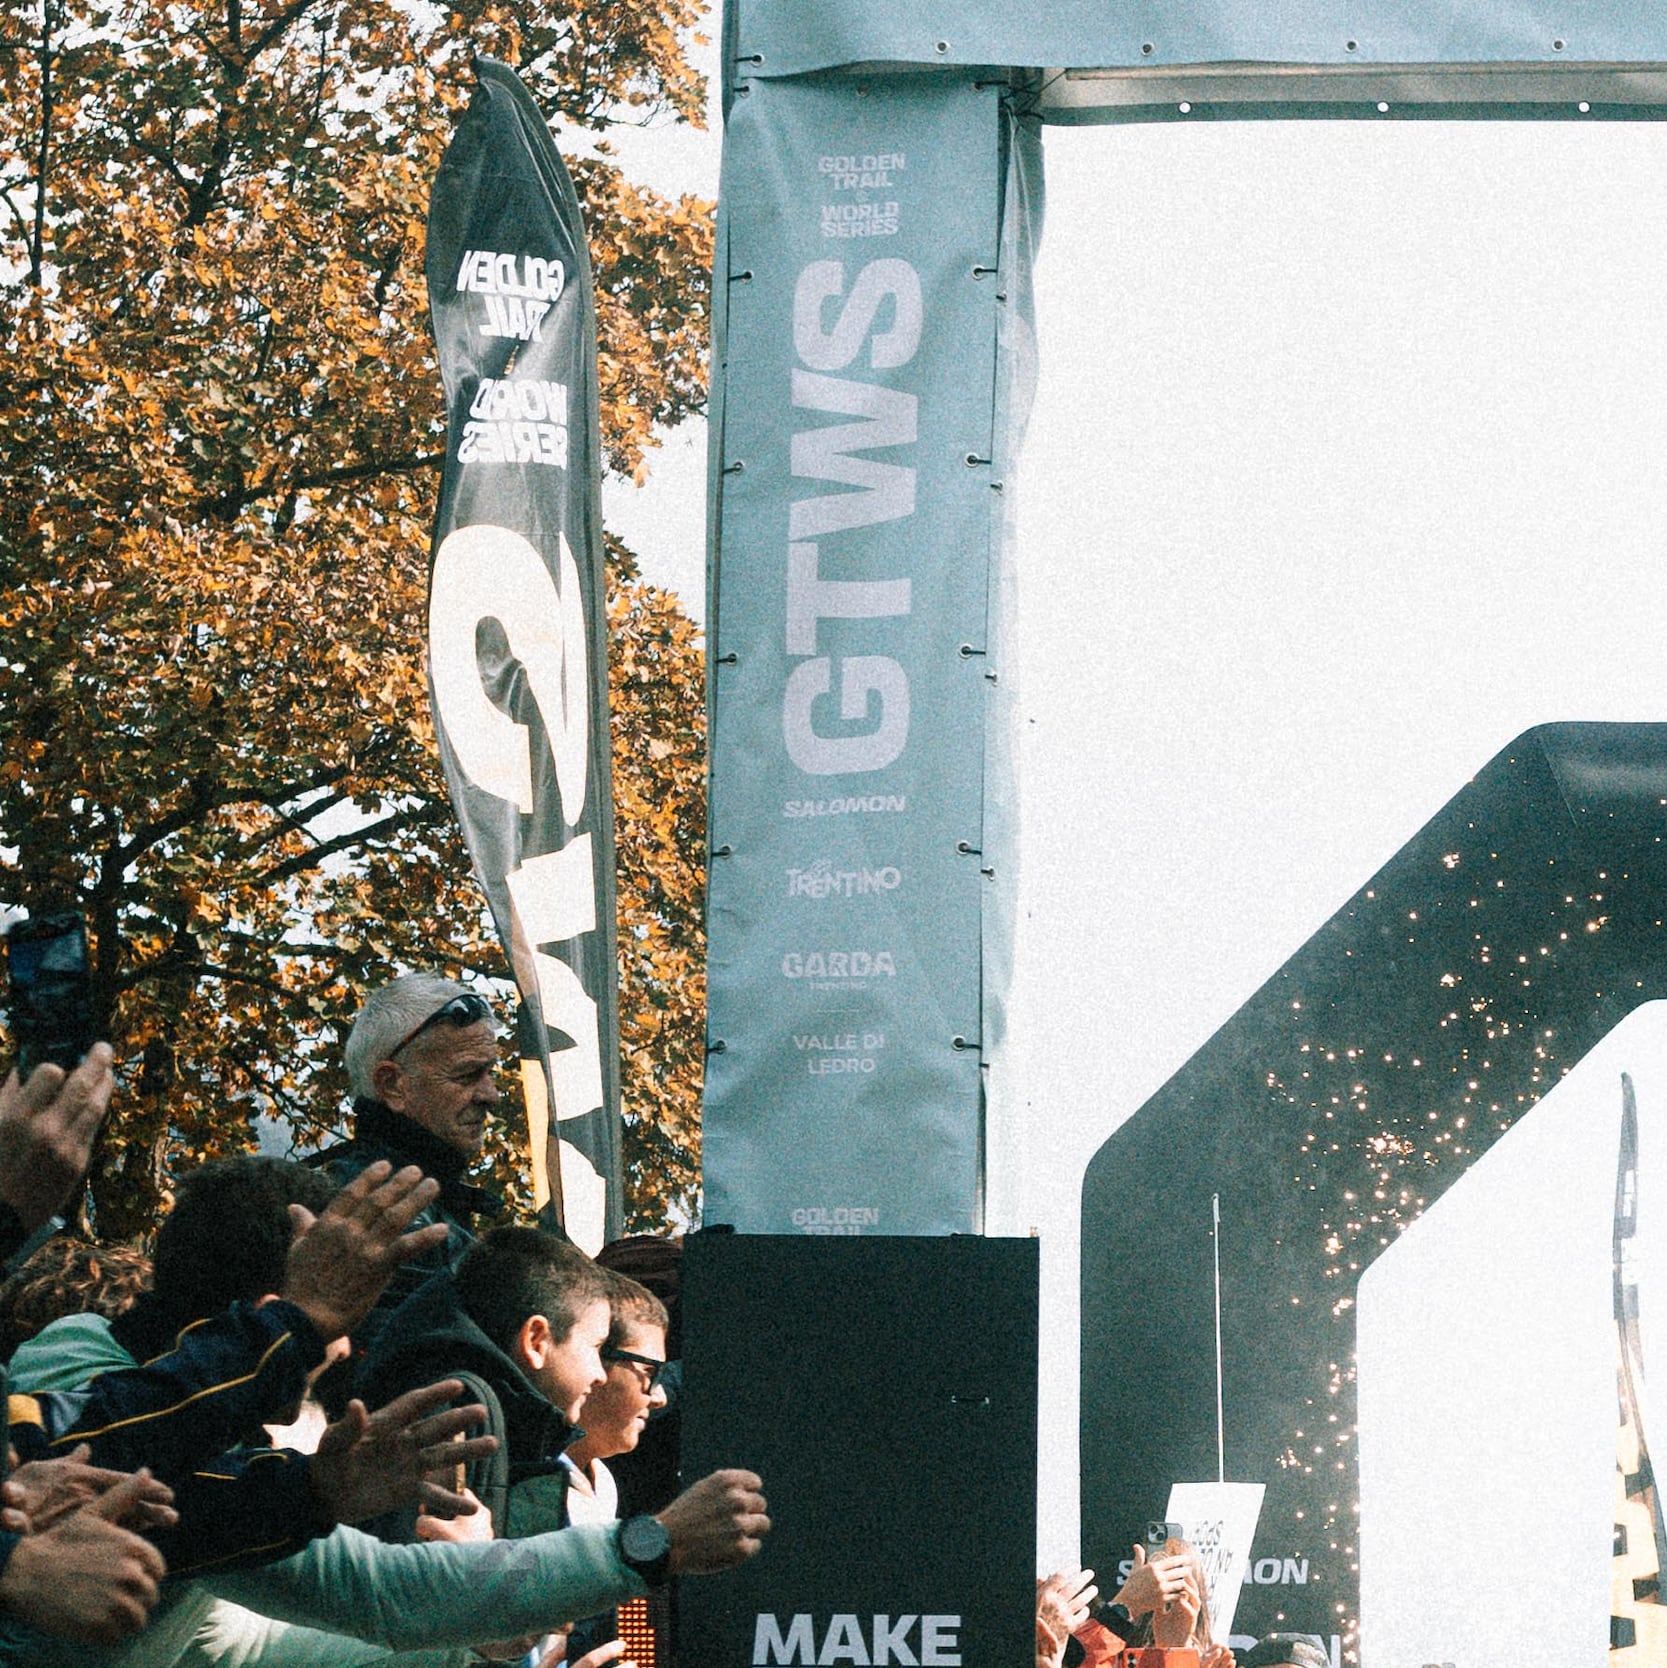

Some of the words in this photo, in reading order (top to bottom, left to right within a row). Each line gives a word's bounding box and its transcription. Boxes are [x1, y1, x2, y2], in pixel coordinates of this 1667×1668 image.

[818, 153, 905, 172] GOLDEN
[832, 171, 893, 189] TRAIL
[821, 202, 899, 220] WORLD
[820, 218, 899, 237] SERIES
[782, 257, 924, 776] GTWS
[783, 795, 906, 817] SALOMON
[786, 865, 900, 898] TRENTINO
[781, 951, 896, 979] GARDA
[793, 1034, 859, 1051] VALLE
[863, 1033, 884, 1049] DI
[807, 1058, 876, 1074] LEDRO
[790, 1208, 879, 1227] GOLDEN
[753, 1613, 962, 1667] MAKE
